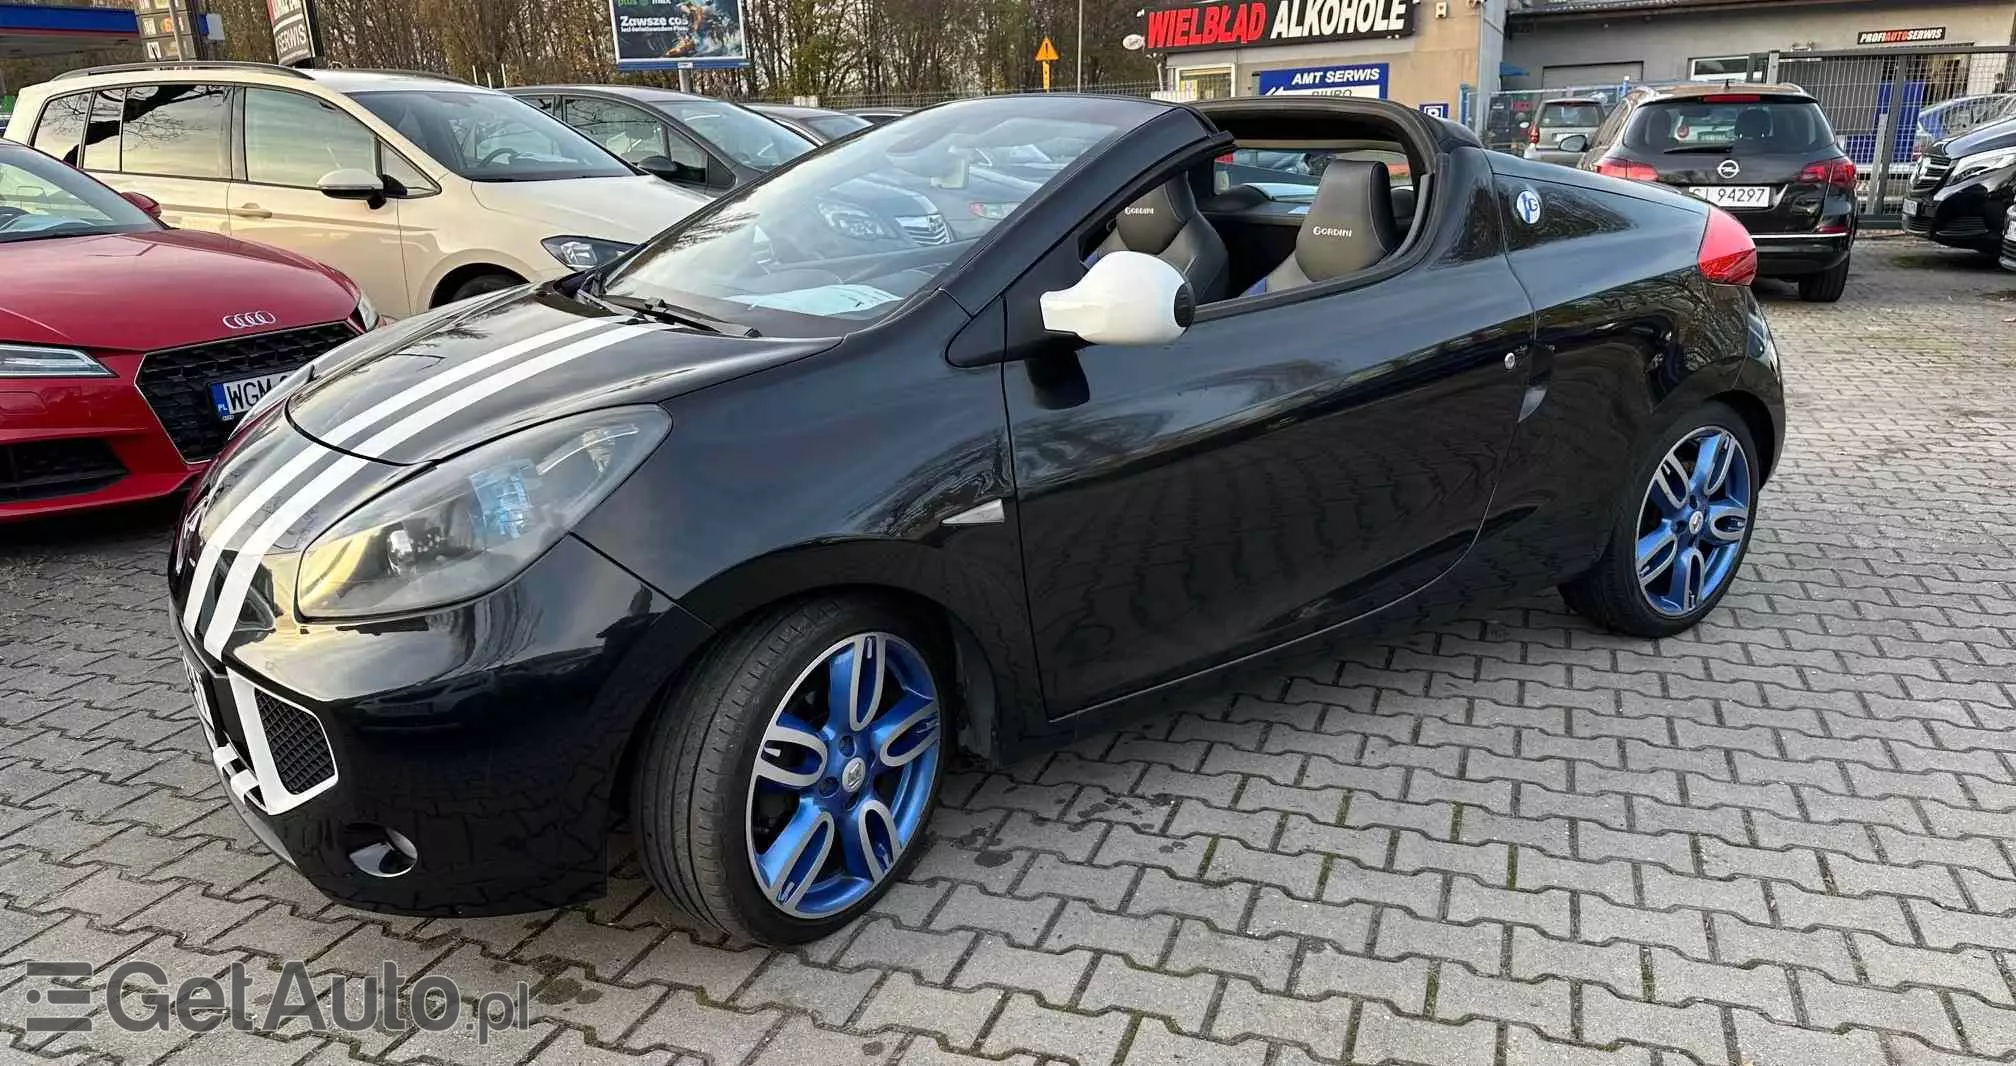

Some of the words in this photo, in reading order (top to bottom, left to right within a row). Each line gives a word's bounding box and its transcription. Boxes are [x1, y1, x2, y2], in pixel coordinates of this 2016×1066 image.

[620, 15, 667, 27] Zawsze
[1147, 2, 1267, 48] WIELBŁĄD
[1270, 0, 1407, 40] ALKOHOLE
[1291, 72, 1324, 85] AMT
[1325, 68, 1381, 83] SERWIS
[1717, 188, 1766, 202] 94297
